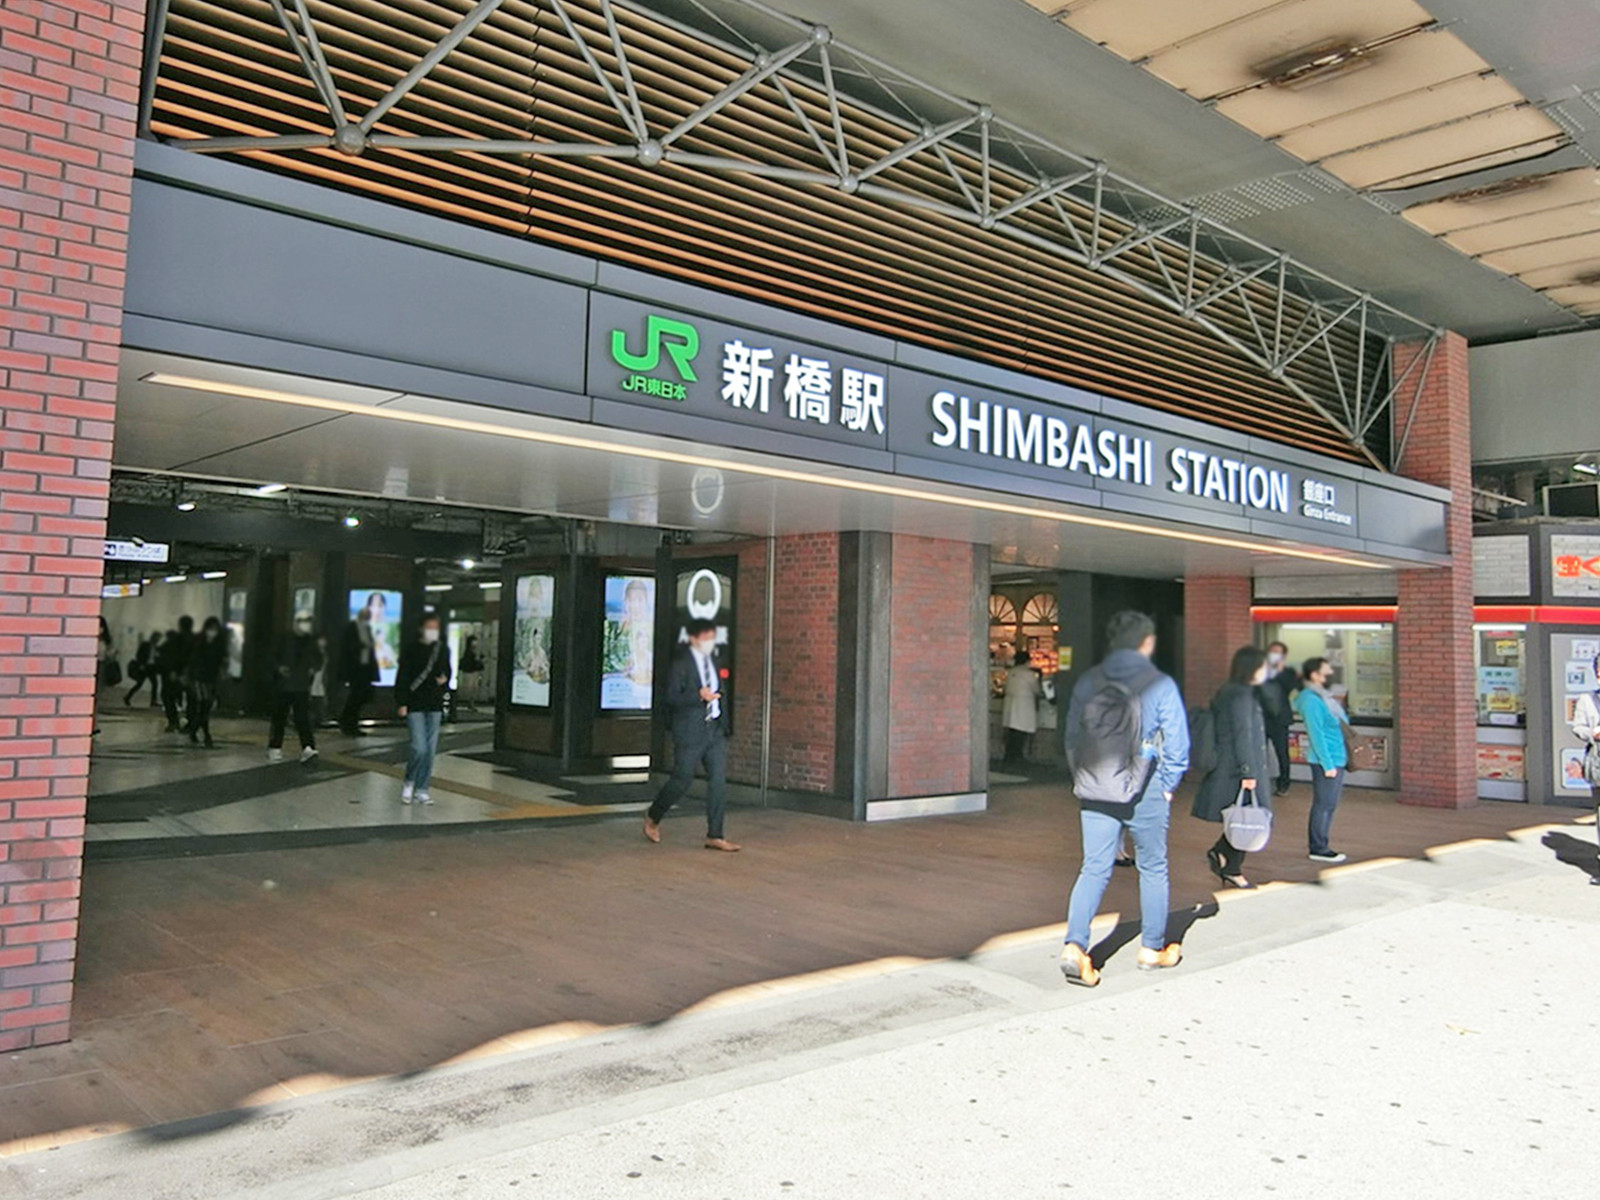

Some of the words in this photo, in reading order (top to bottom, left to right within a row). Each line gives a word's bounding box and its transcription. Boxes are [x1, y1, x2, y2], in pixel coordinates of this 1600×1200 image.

[611, 315, 700, 382] JR
[621, 377, 687, 401] JR東日本
[720, 339, 886, 435] 新橋駅
[931, 390, 1153, 486] SHIMBASHI
[1171, 447, 1290, 513] STATION
